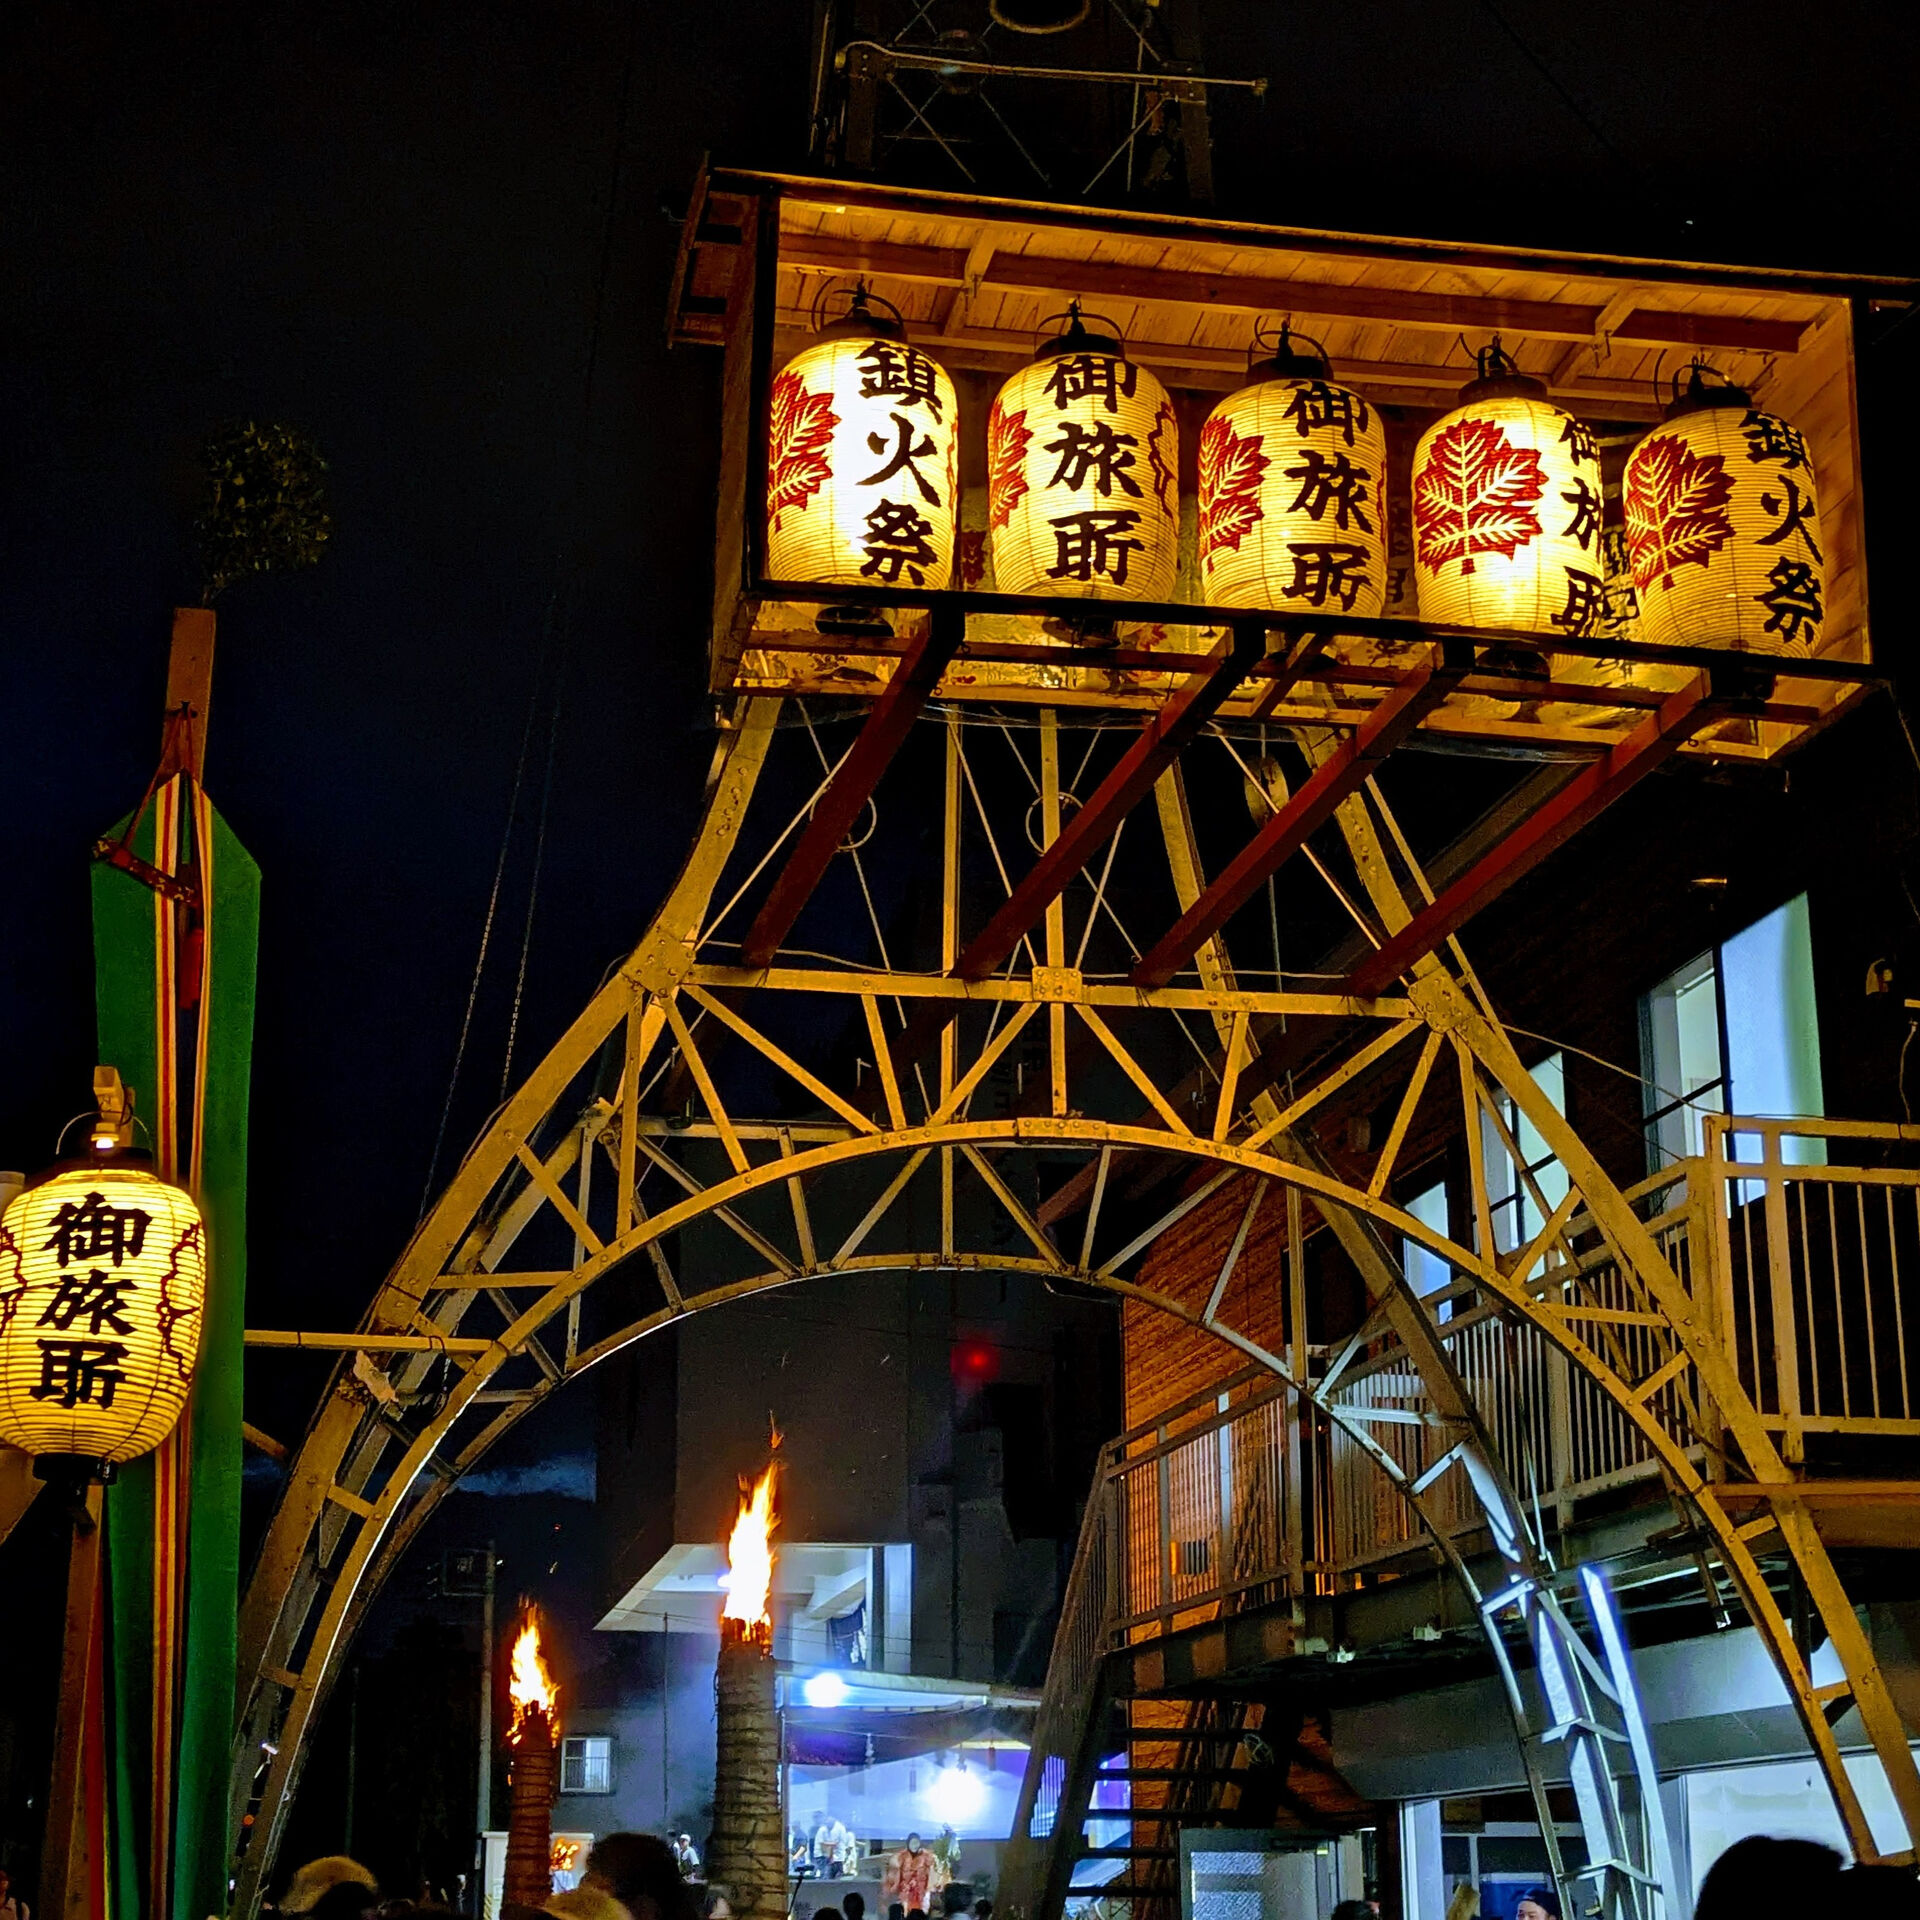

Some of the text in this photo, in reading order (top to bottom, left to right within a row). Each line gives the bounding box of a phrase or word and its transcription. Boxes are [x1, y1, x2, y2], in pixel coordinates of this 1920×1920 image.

[1043, 354, 1146, 586] 御旅所
[1280, 380, 1374, 612] 御旅所
[29, 1191, 153, 1410] 御旅所
